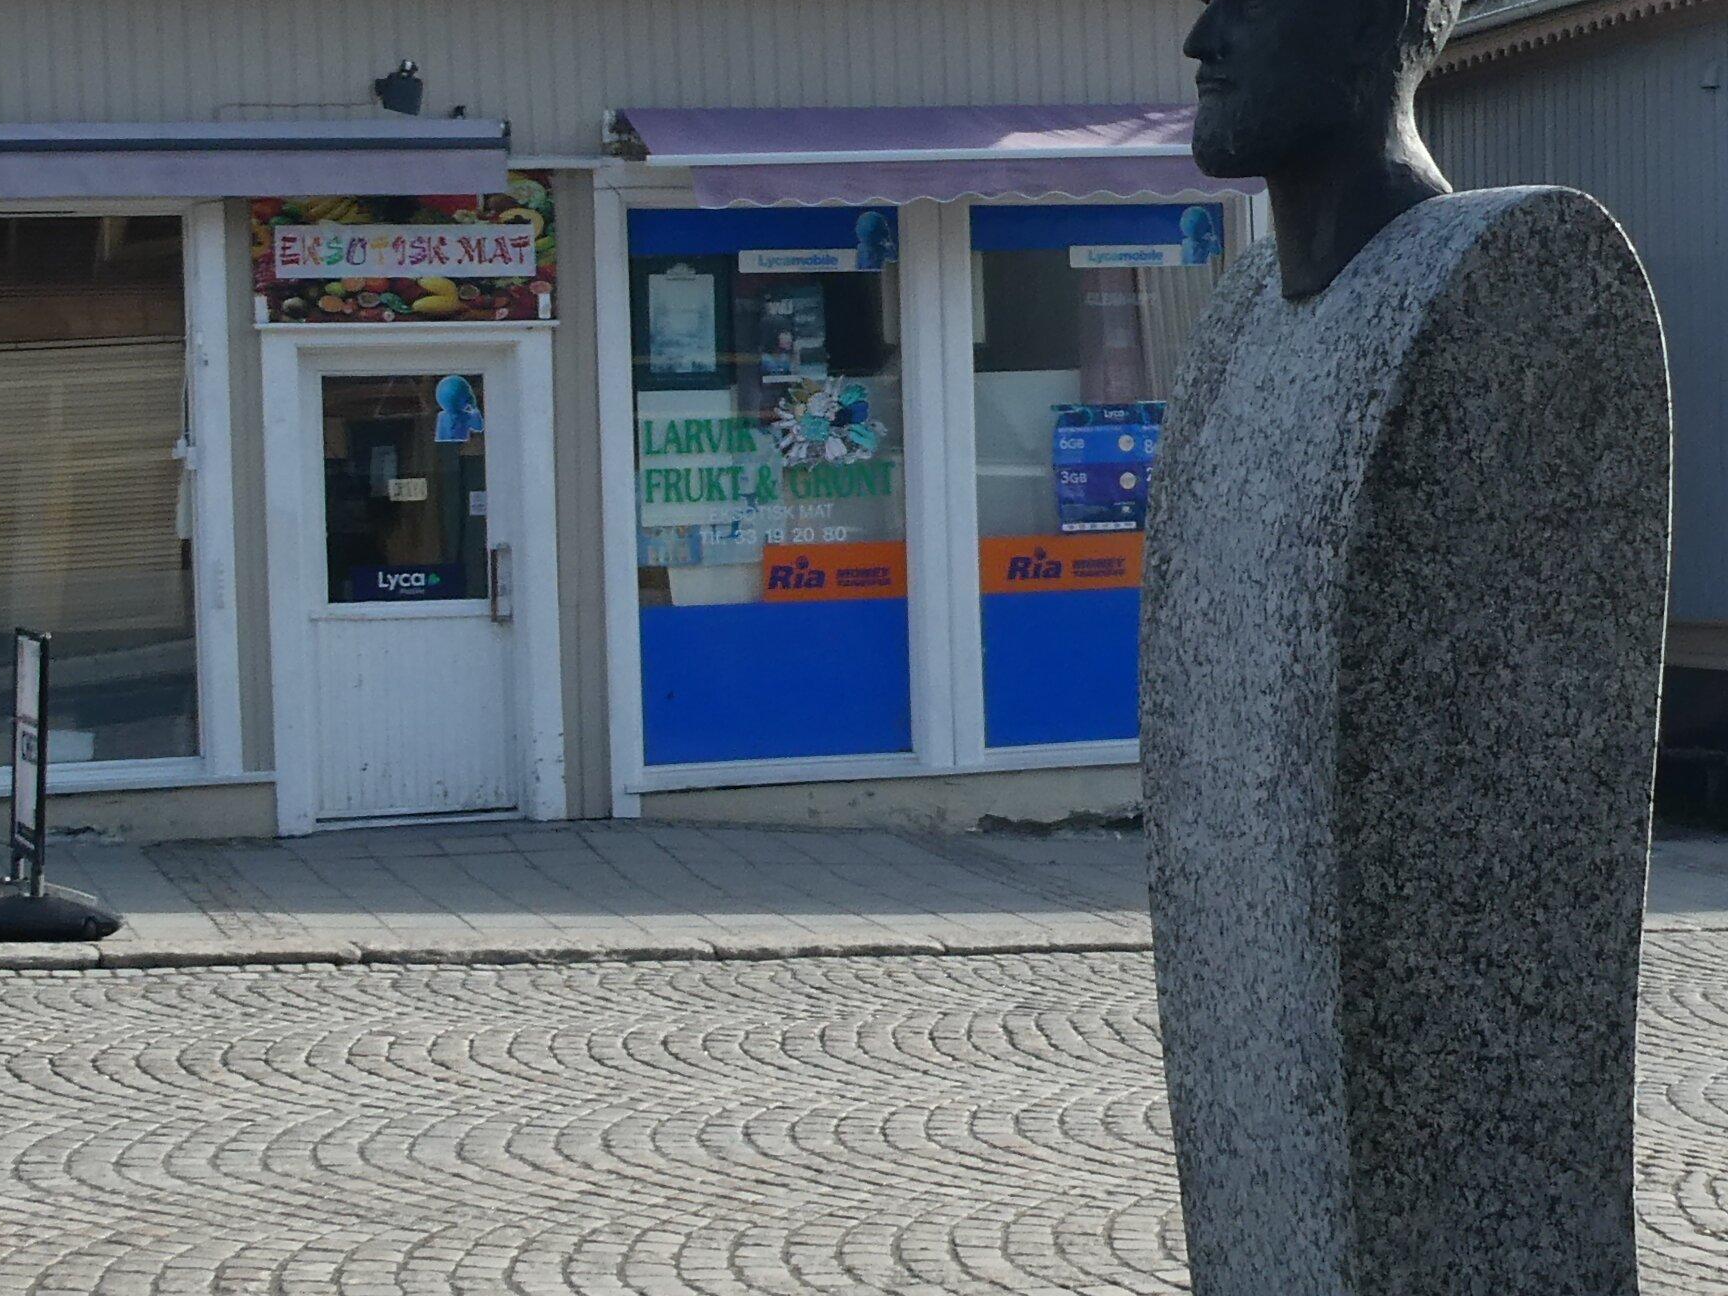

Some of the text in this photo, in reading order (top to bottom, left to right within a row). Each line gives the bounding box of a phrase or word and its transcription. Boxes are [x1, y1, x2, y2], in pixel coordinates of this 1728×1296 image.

[280, 235, 531, 266] EKSOTISK MAT
[643, 417, 758, 455] LARVIK
[644, 465, 744, 504] FRUKT
[1060, 470, 1088, 484] 3GB
[799, 502, 835, 519] MAT
[765, 527, 785, 543] 19
[791, 526, 816, 542] 20
[822, 525, 848, 541] 80
[767, 555, 827, 590] Ria
[1007, 545, 1063, 580] Ria
[377, 571, 426, 591] Lyca
